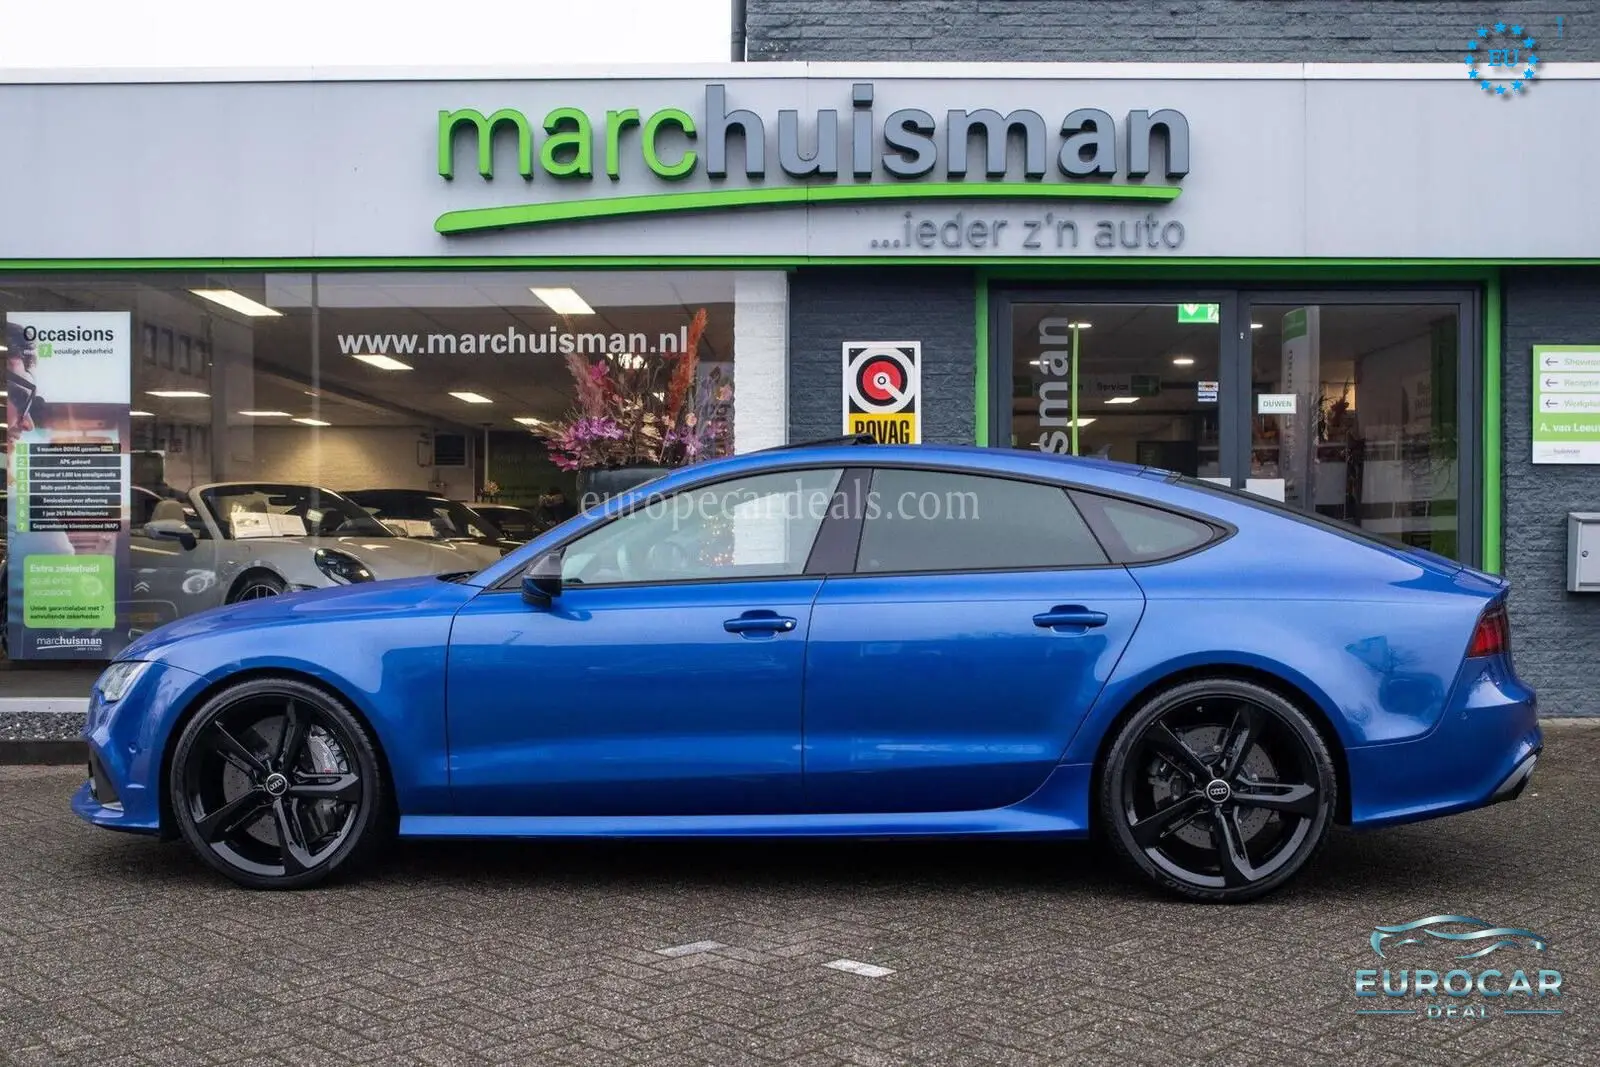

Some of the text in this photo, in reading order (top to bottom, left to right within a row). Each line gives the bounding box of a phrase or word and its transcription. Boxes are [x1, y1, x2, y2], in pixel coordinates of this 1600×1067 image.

[438, 84, 1190, 182] marchuisman
[871, 212, 1186, 250] ...ieder z'n auto
[23, 325, 114, 342] Occasions
[338, 326, 688, 354] www.marchuisman.nl
[54, 347, 80, 355] voudige
[1552, 424, 1571, 432] van
[37, 635, 102, 645] marchuisman
